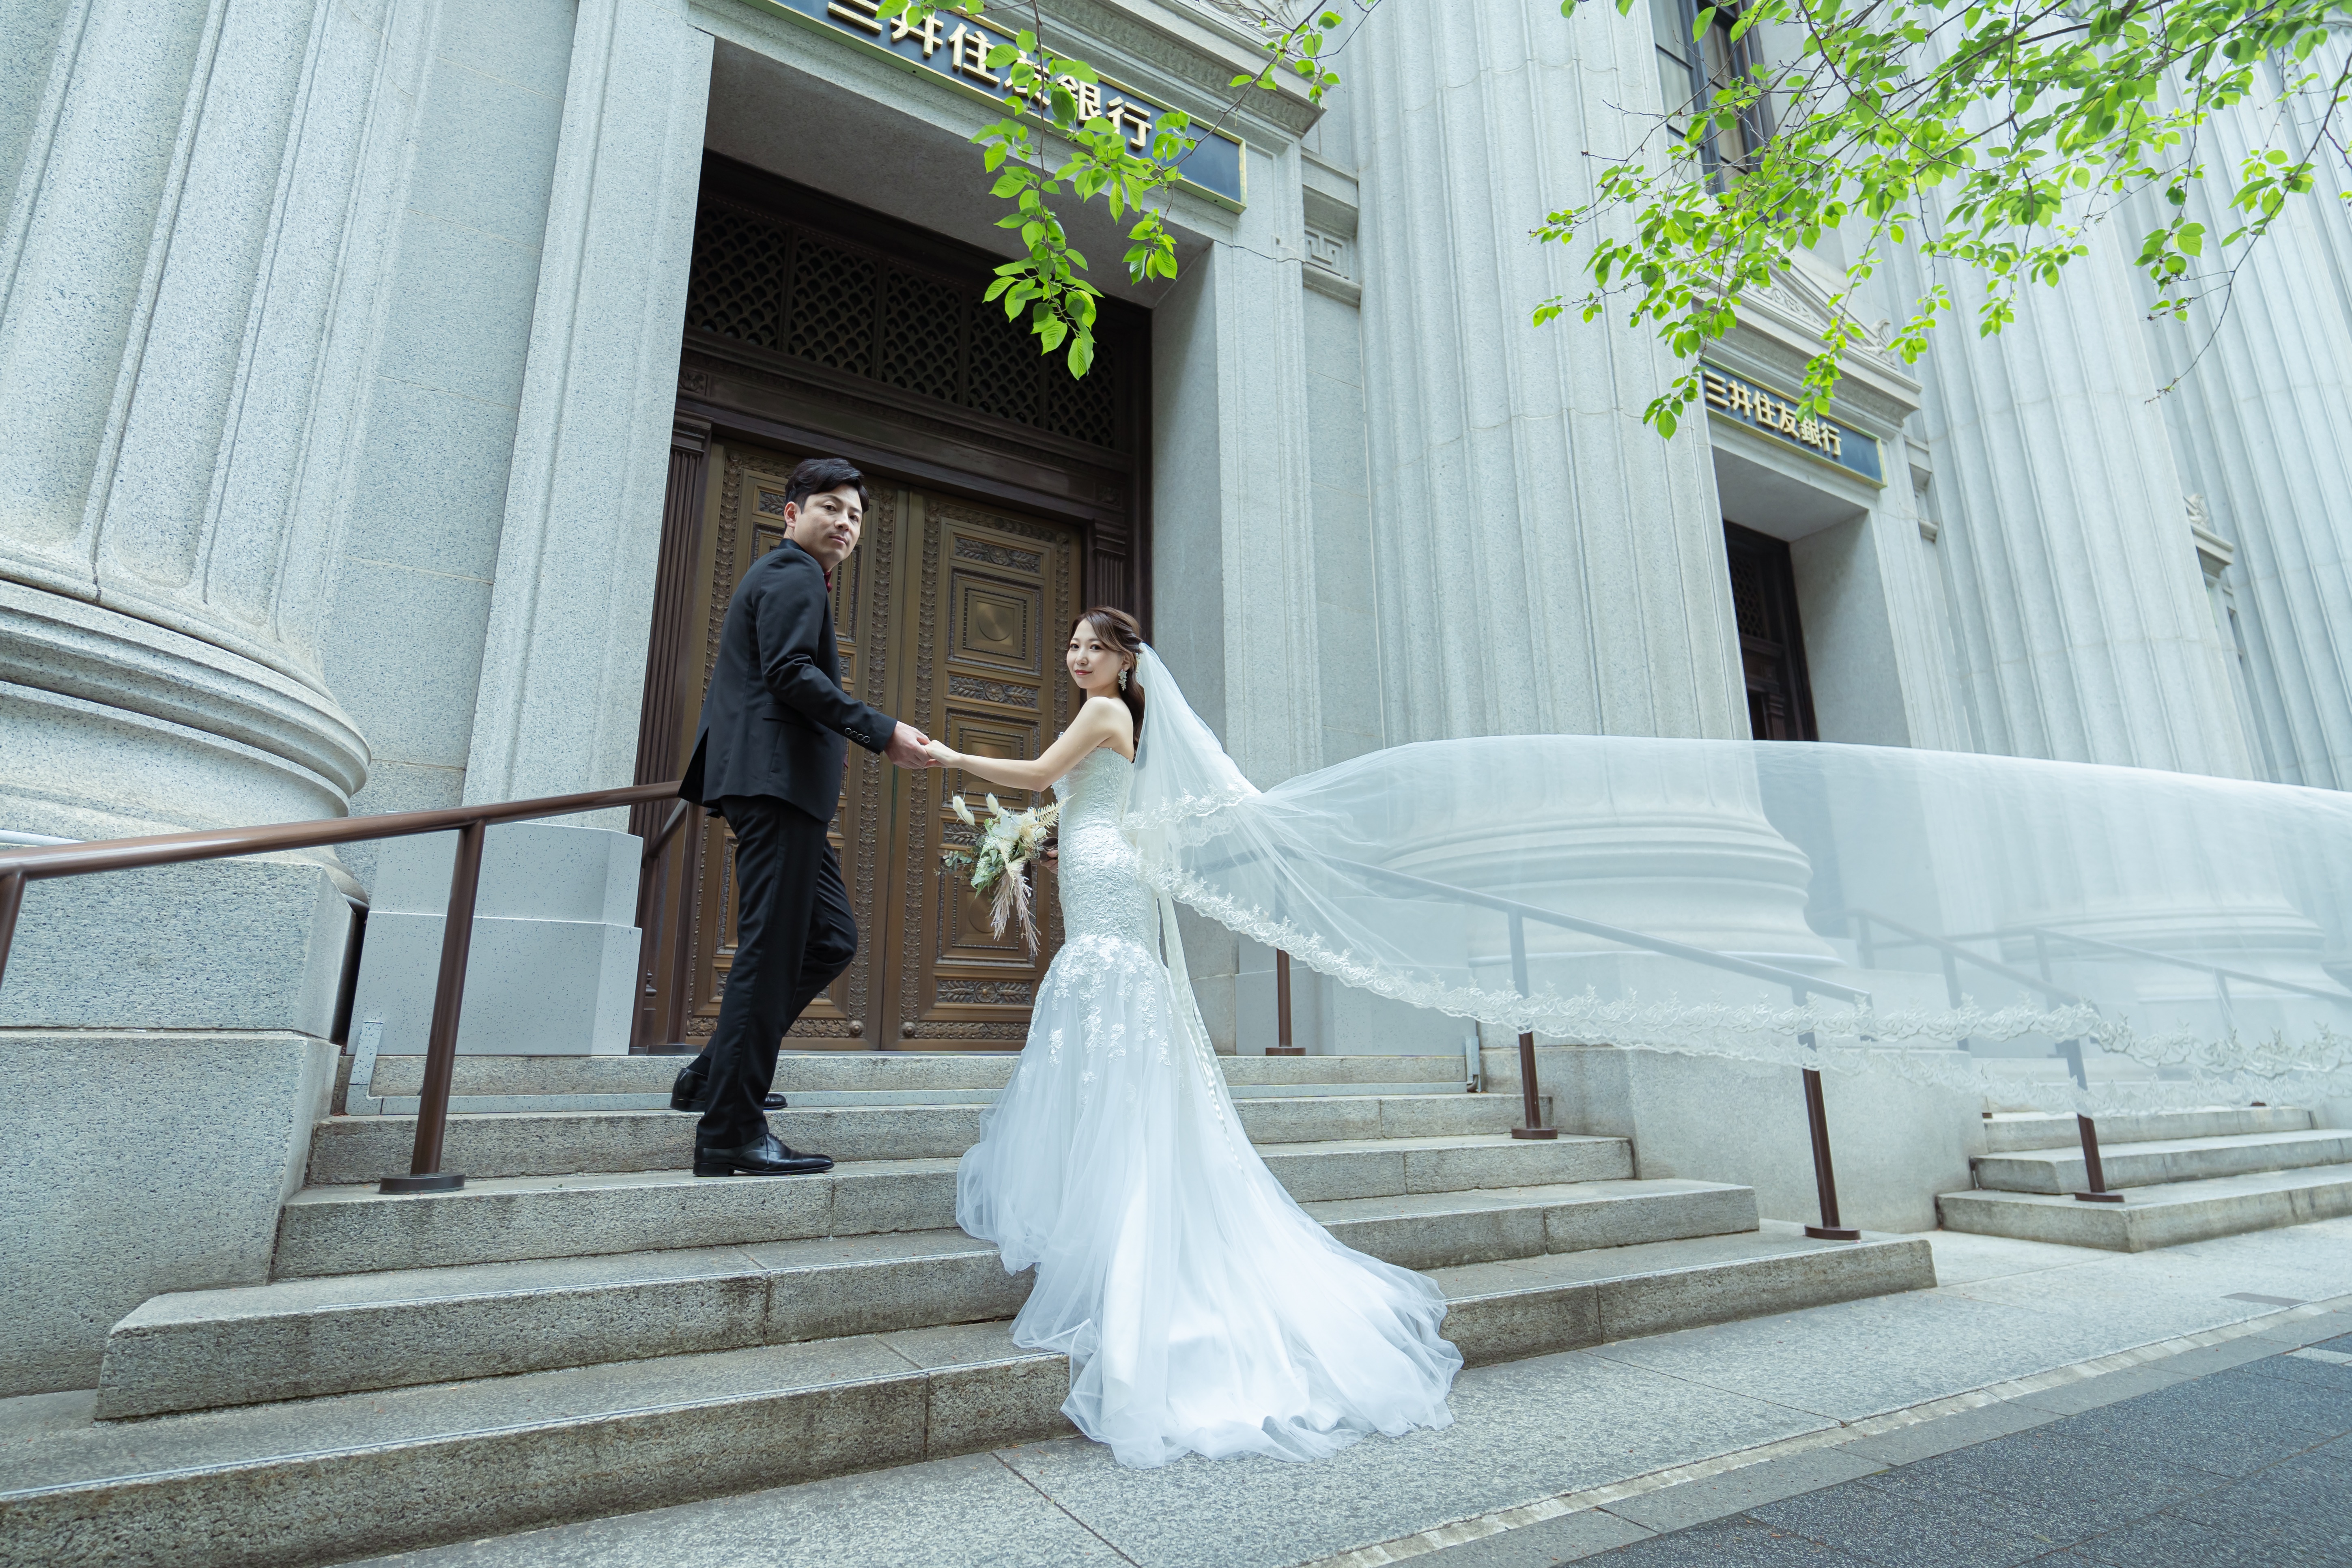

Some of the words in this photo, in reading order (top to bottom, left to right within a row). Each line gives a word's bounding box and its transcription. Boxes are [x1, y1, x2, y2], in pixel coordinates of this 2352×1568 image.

[1704, 370, 1842, 456] 三井住友銀行
